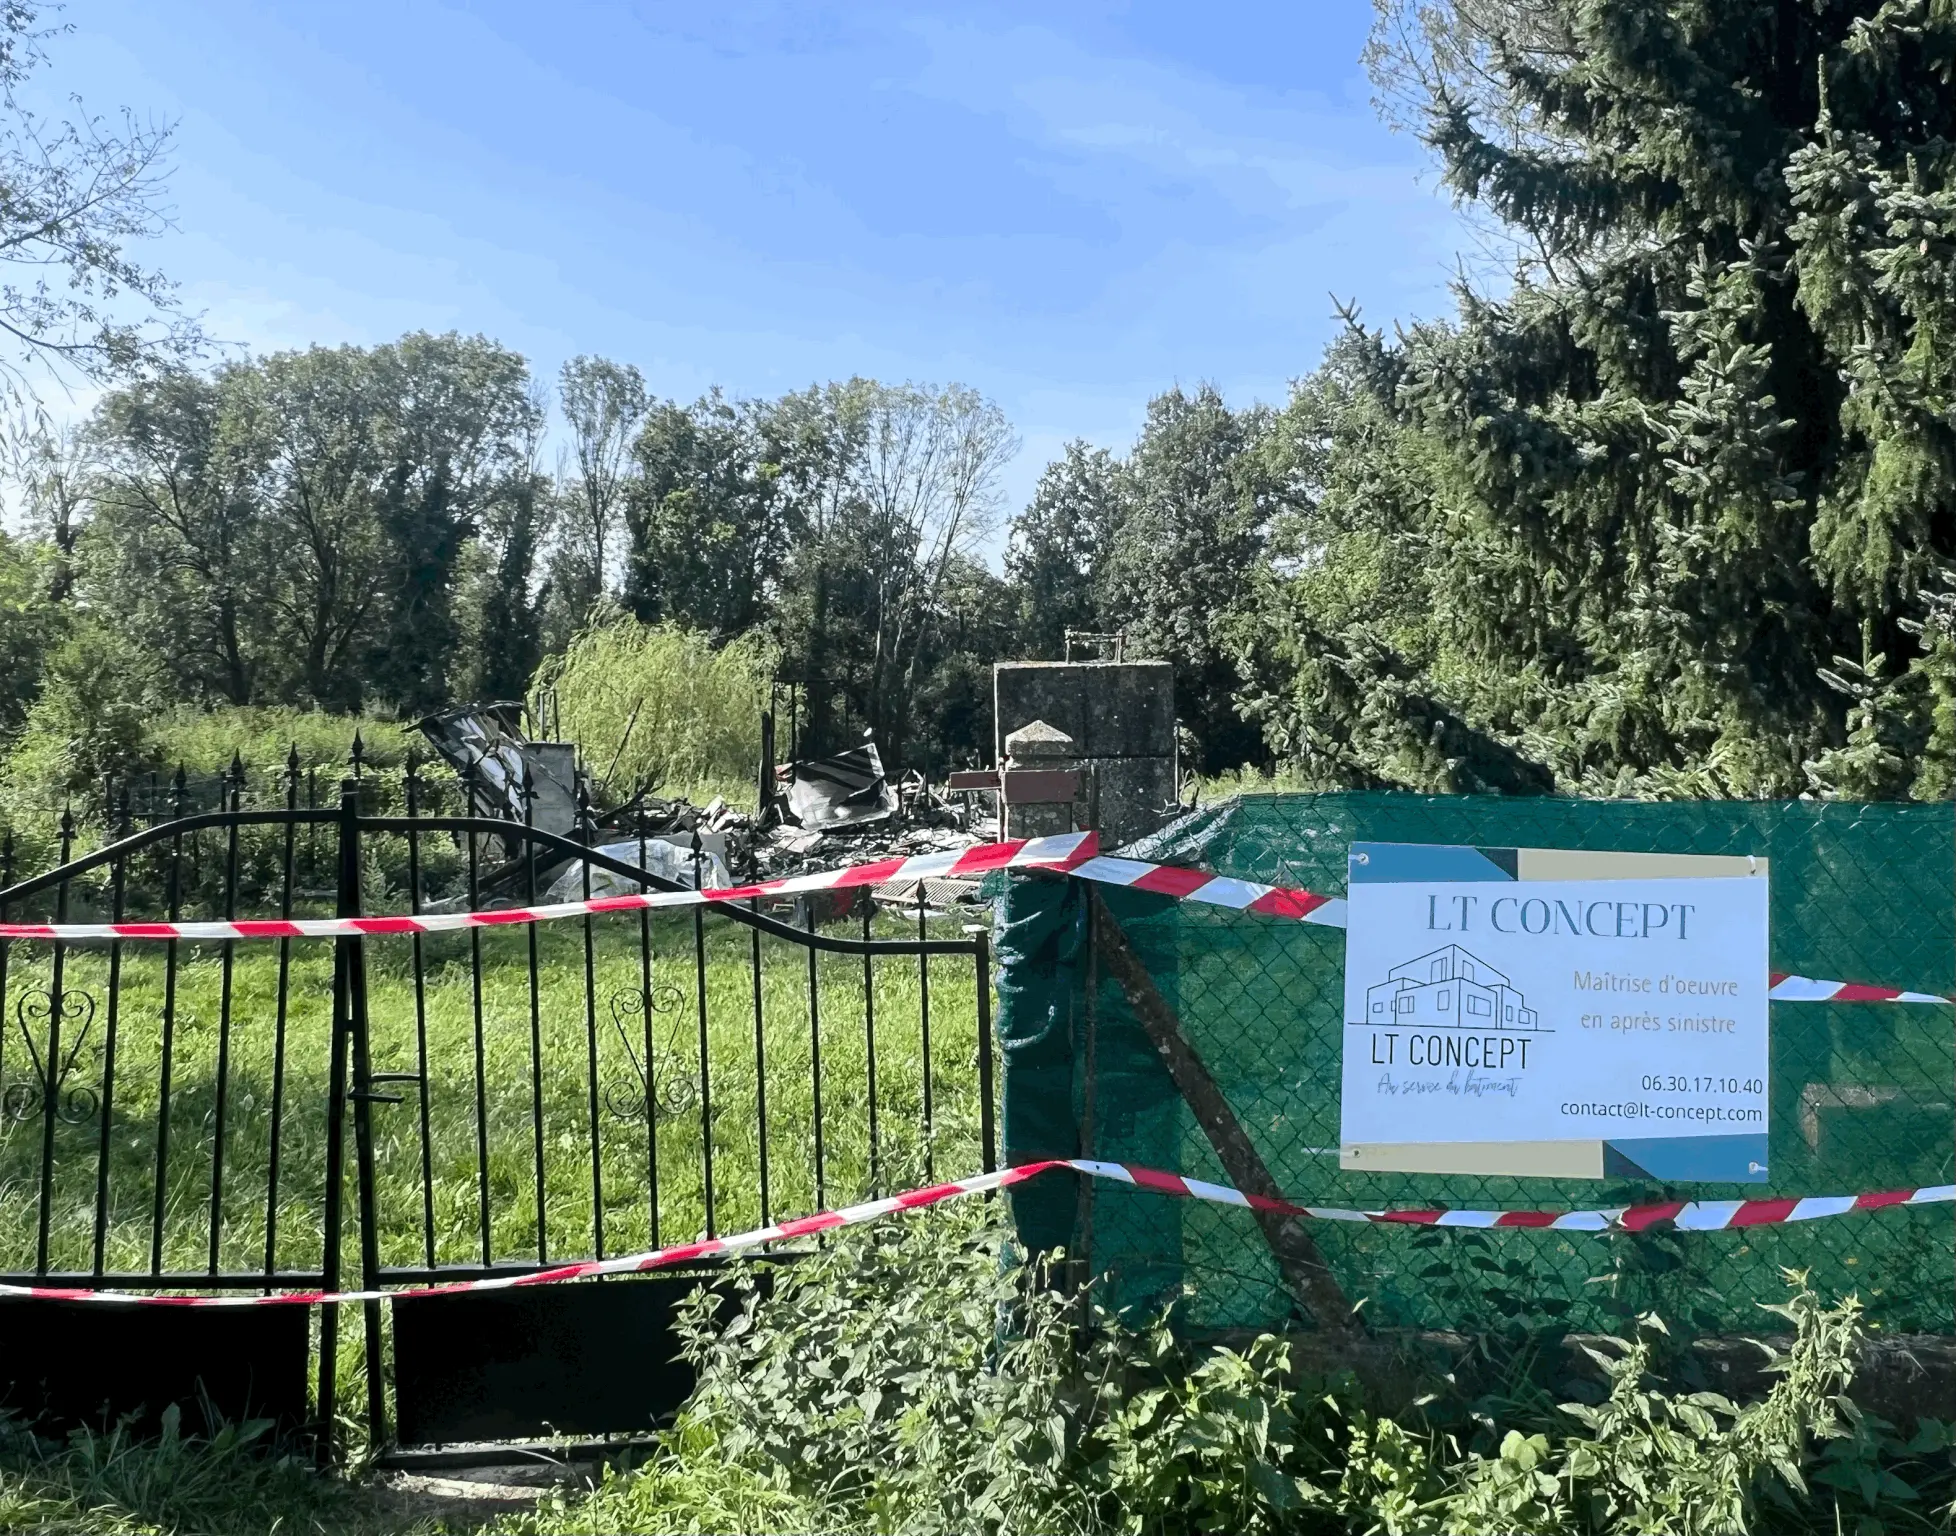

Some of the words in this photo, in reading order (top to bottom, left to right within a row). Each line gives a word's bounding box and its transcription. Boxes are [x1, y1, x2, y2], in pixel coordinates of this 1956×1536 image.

[1427, 894, 1478, 931] LT
[1490, 897, 1696, 940] CONCEPT
[1573, 970, 1652, 993] Maîtrise
[1658, 974, 1739, 997] d'oeuvre
[1580, 1013, 1602, 1029] en
[1610, 1010, 1662, 1035] après
[1667, 1012, 1736, 1034] sinistre
[1371, 1033, 1399, 1065] LT
[1408, 1034, 1532, 1070] CONCEPT
[1641, 1075, 1763, 1094] 06.30.17.10.40
[1560, 1101, 1763, 1124] contact@lt-concept.com
